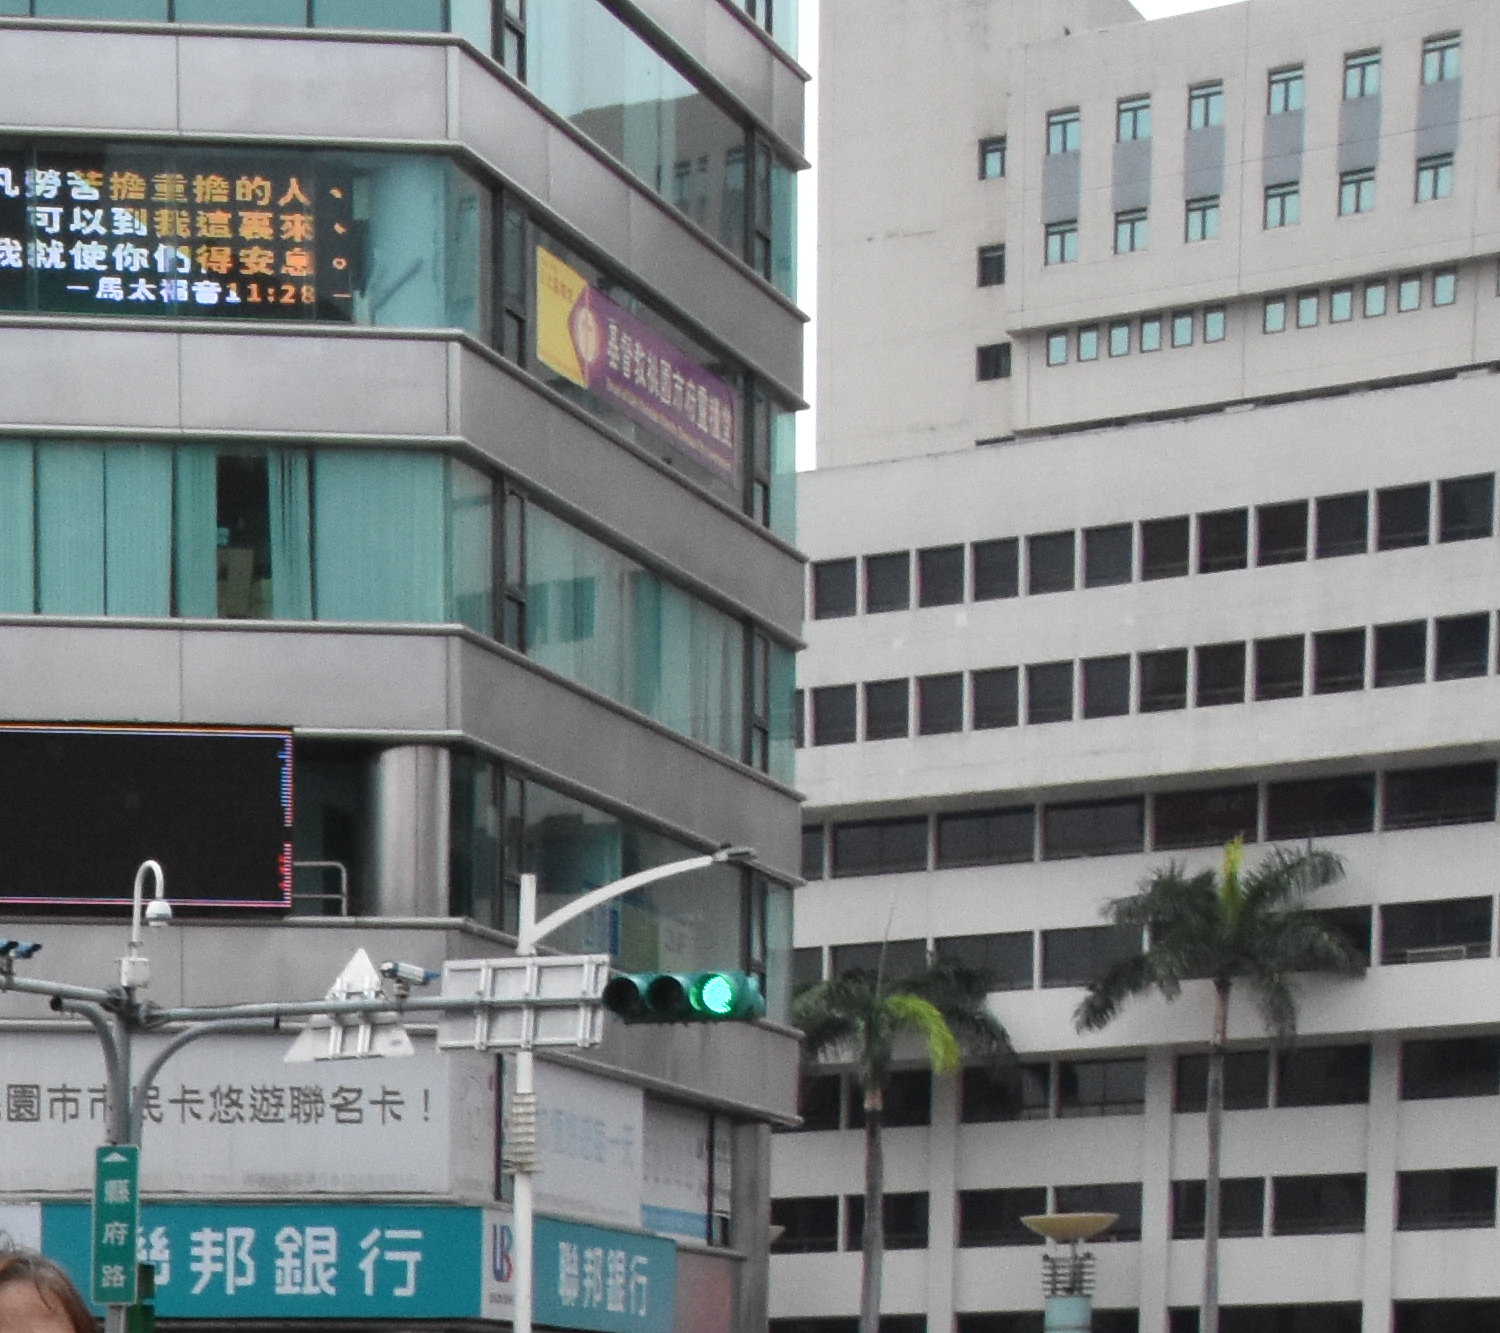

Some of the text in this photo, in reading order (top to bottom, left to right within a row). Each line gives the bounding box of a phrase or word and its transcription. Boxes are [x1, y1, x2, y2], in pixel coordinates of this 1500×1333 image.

[101, 1178, 131, 1289] 縣府路
[558, 1240, 649, 1317] 聯邦銀行
